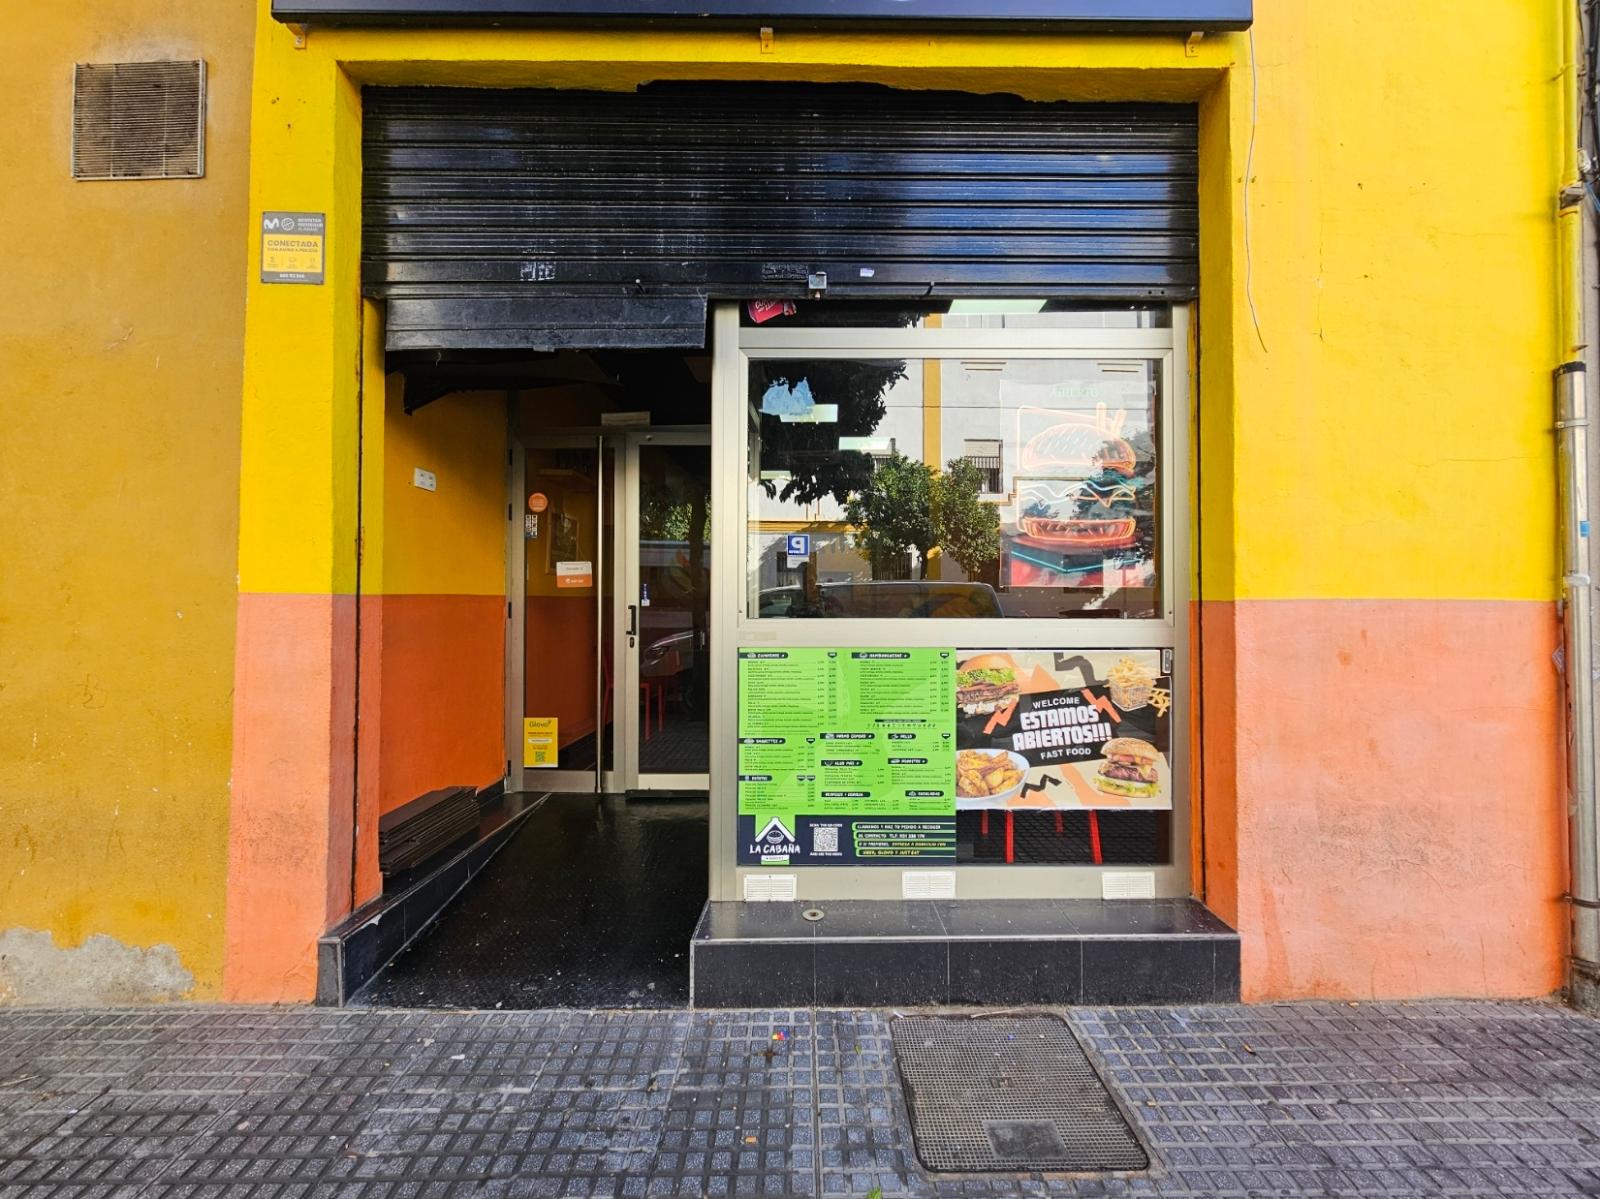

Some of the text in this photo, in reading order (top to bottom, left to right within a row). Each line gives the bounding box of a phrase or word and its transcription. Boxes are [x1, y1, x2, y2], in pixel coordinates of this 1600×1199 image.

[1032, 697, 1080, 709] WELCOME
[1020, 704, 1100, 730] ESTAMOS
[1012, 722, 1112, 751] ABIERTOS!!!
[1040, 748, 1092, 760] FAST FOOD
[750, 844, 800, 854] LA CABAÑA
